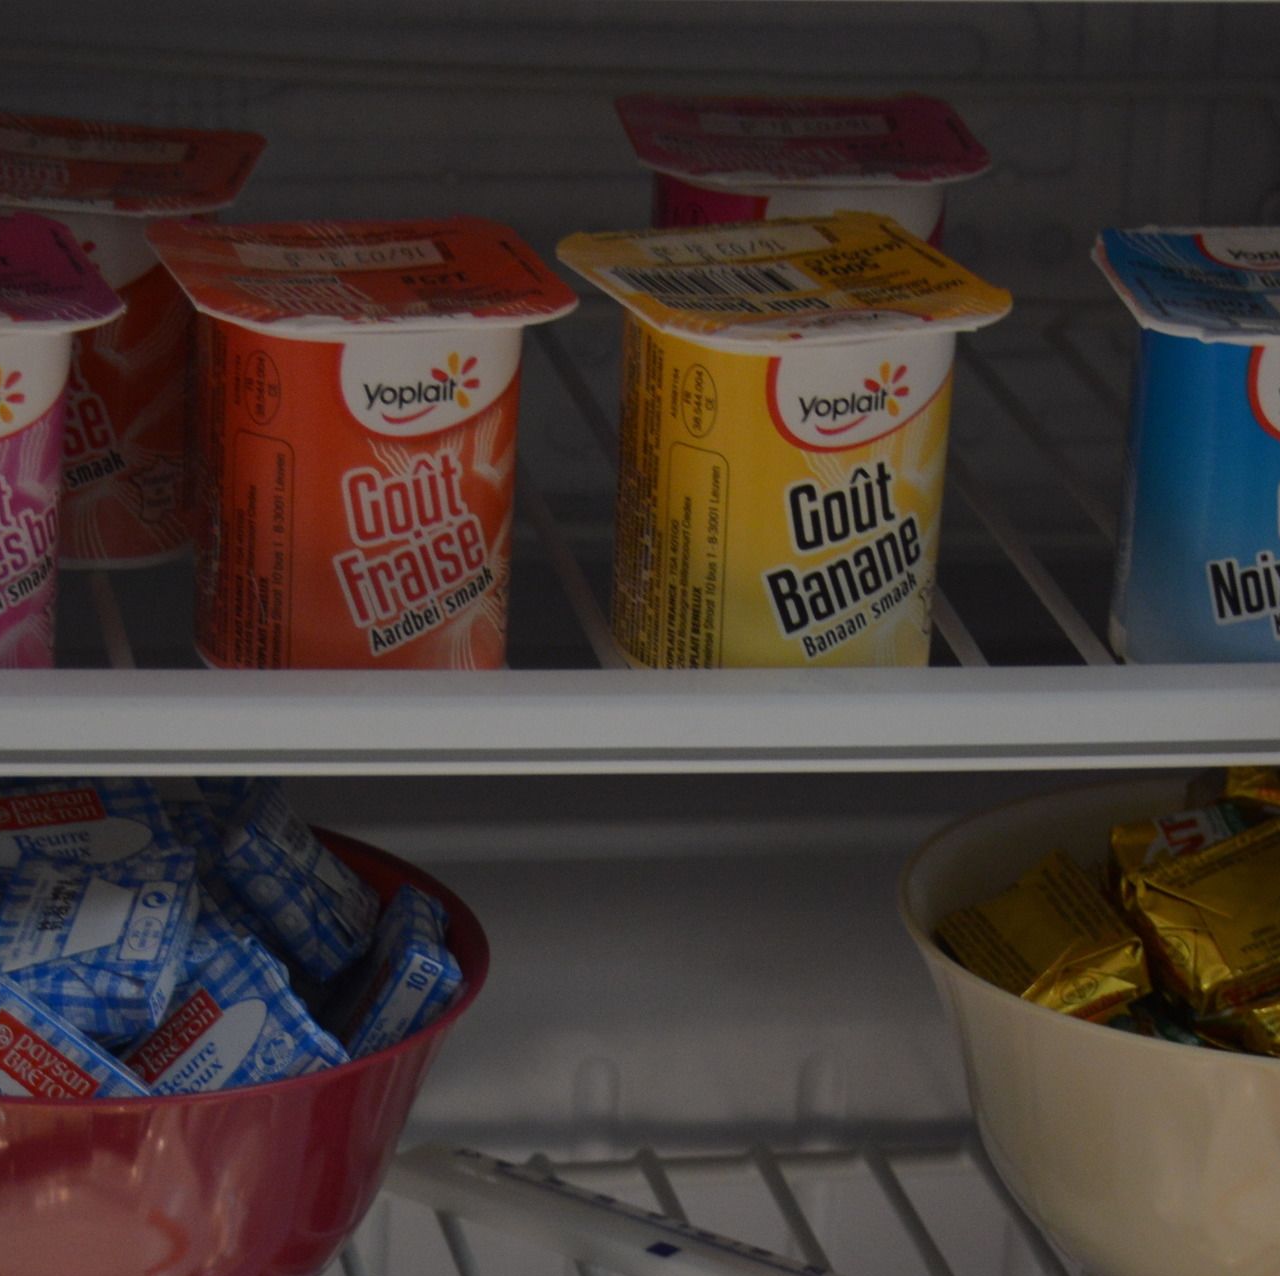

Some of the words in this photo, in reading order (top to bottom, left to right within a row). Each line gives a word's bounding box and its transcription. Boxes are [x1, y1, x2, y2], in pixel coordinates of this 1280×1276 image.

[363, 377, 458, 411] Yoplait
[798, 386, 889, 422] Yoplait
[64, 449, 126, 488] smaak
[346, 453, 462, 542] Goût
[789, 461, 895, 551] Goût
[9, 555, 55, 602] smaak
[338, 517, 486, 622] Fraise
[767, 517, 921, 635] Banane
[371, 602, 441, 653] Aardbei
[445, 565, 496, 617] smaak
[803, 614, 868, 660] Banaan
[872, 572, 918, 619] smaak
[14, 831, 90, 850] Beurre
[406, 971, 430, 992] 10
[2, 1049, 78, 1098] BRETO
